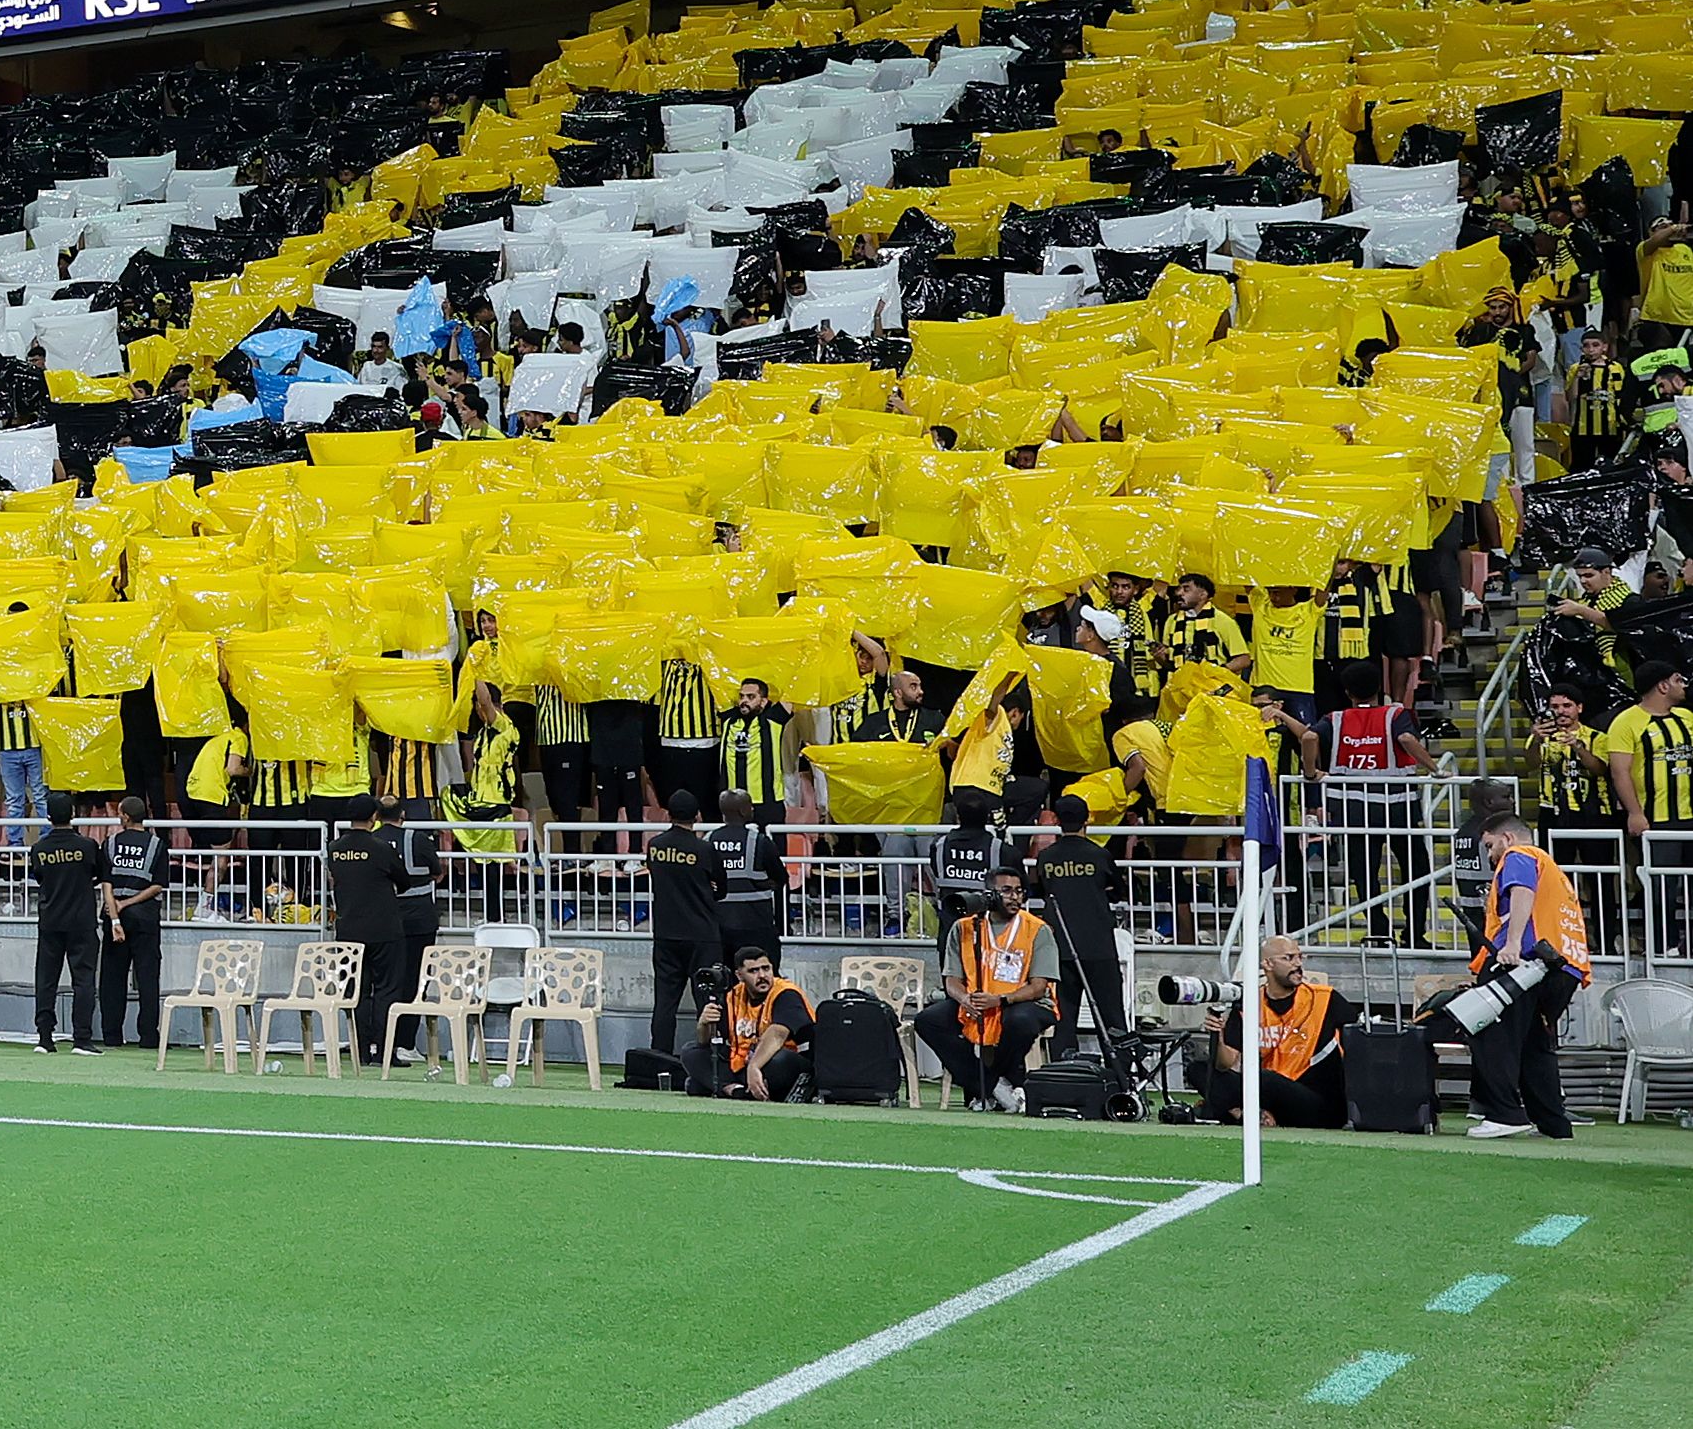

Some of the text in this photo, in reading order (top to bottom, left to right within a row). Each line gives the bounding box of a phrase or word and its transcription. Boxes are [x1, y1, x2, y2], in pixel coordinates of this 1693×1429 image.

[1348, 754, 1377, 769] 175
[37, 849, 83, 866] Police
[117, 844, 143, 856] 1192
[332, 850, 369, 861] Police
[649, 846, 697, 865] Police
[950, 848, 983, 861] 1184
[113, 855, 144, 869] Guard
[1455, 856, 1480, 871] Guard
[1043, 861, 1095, 879] Police
